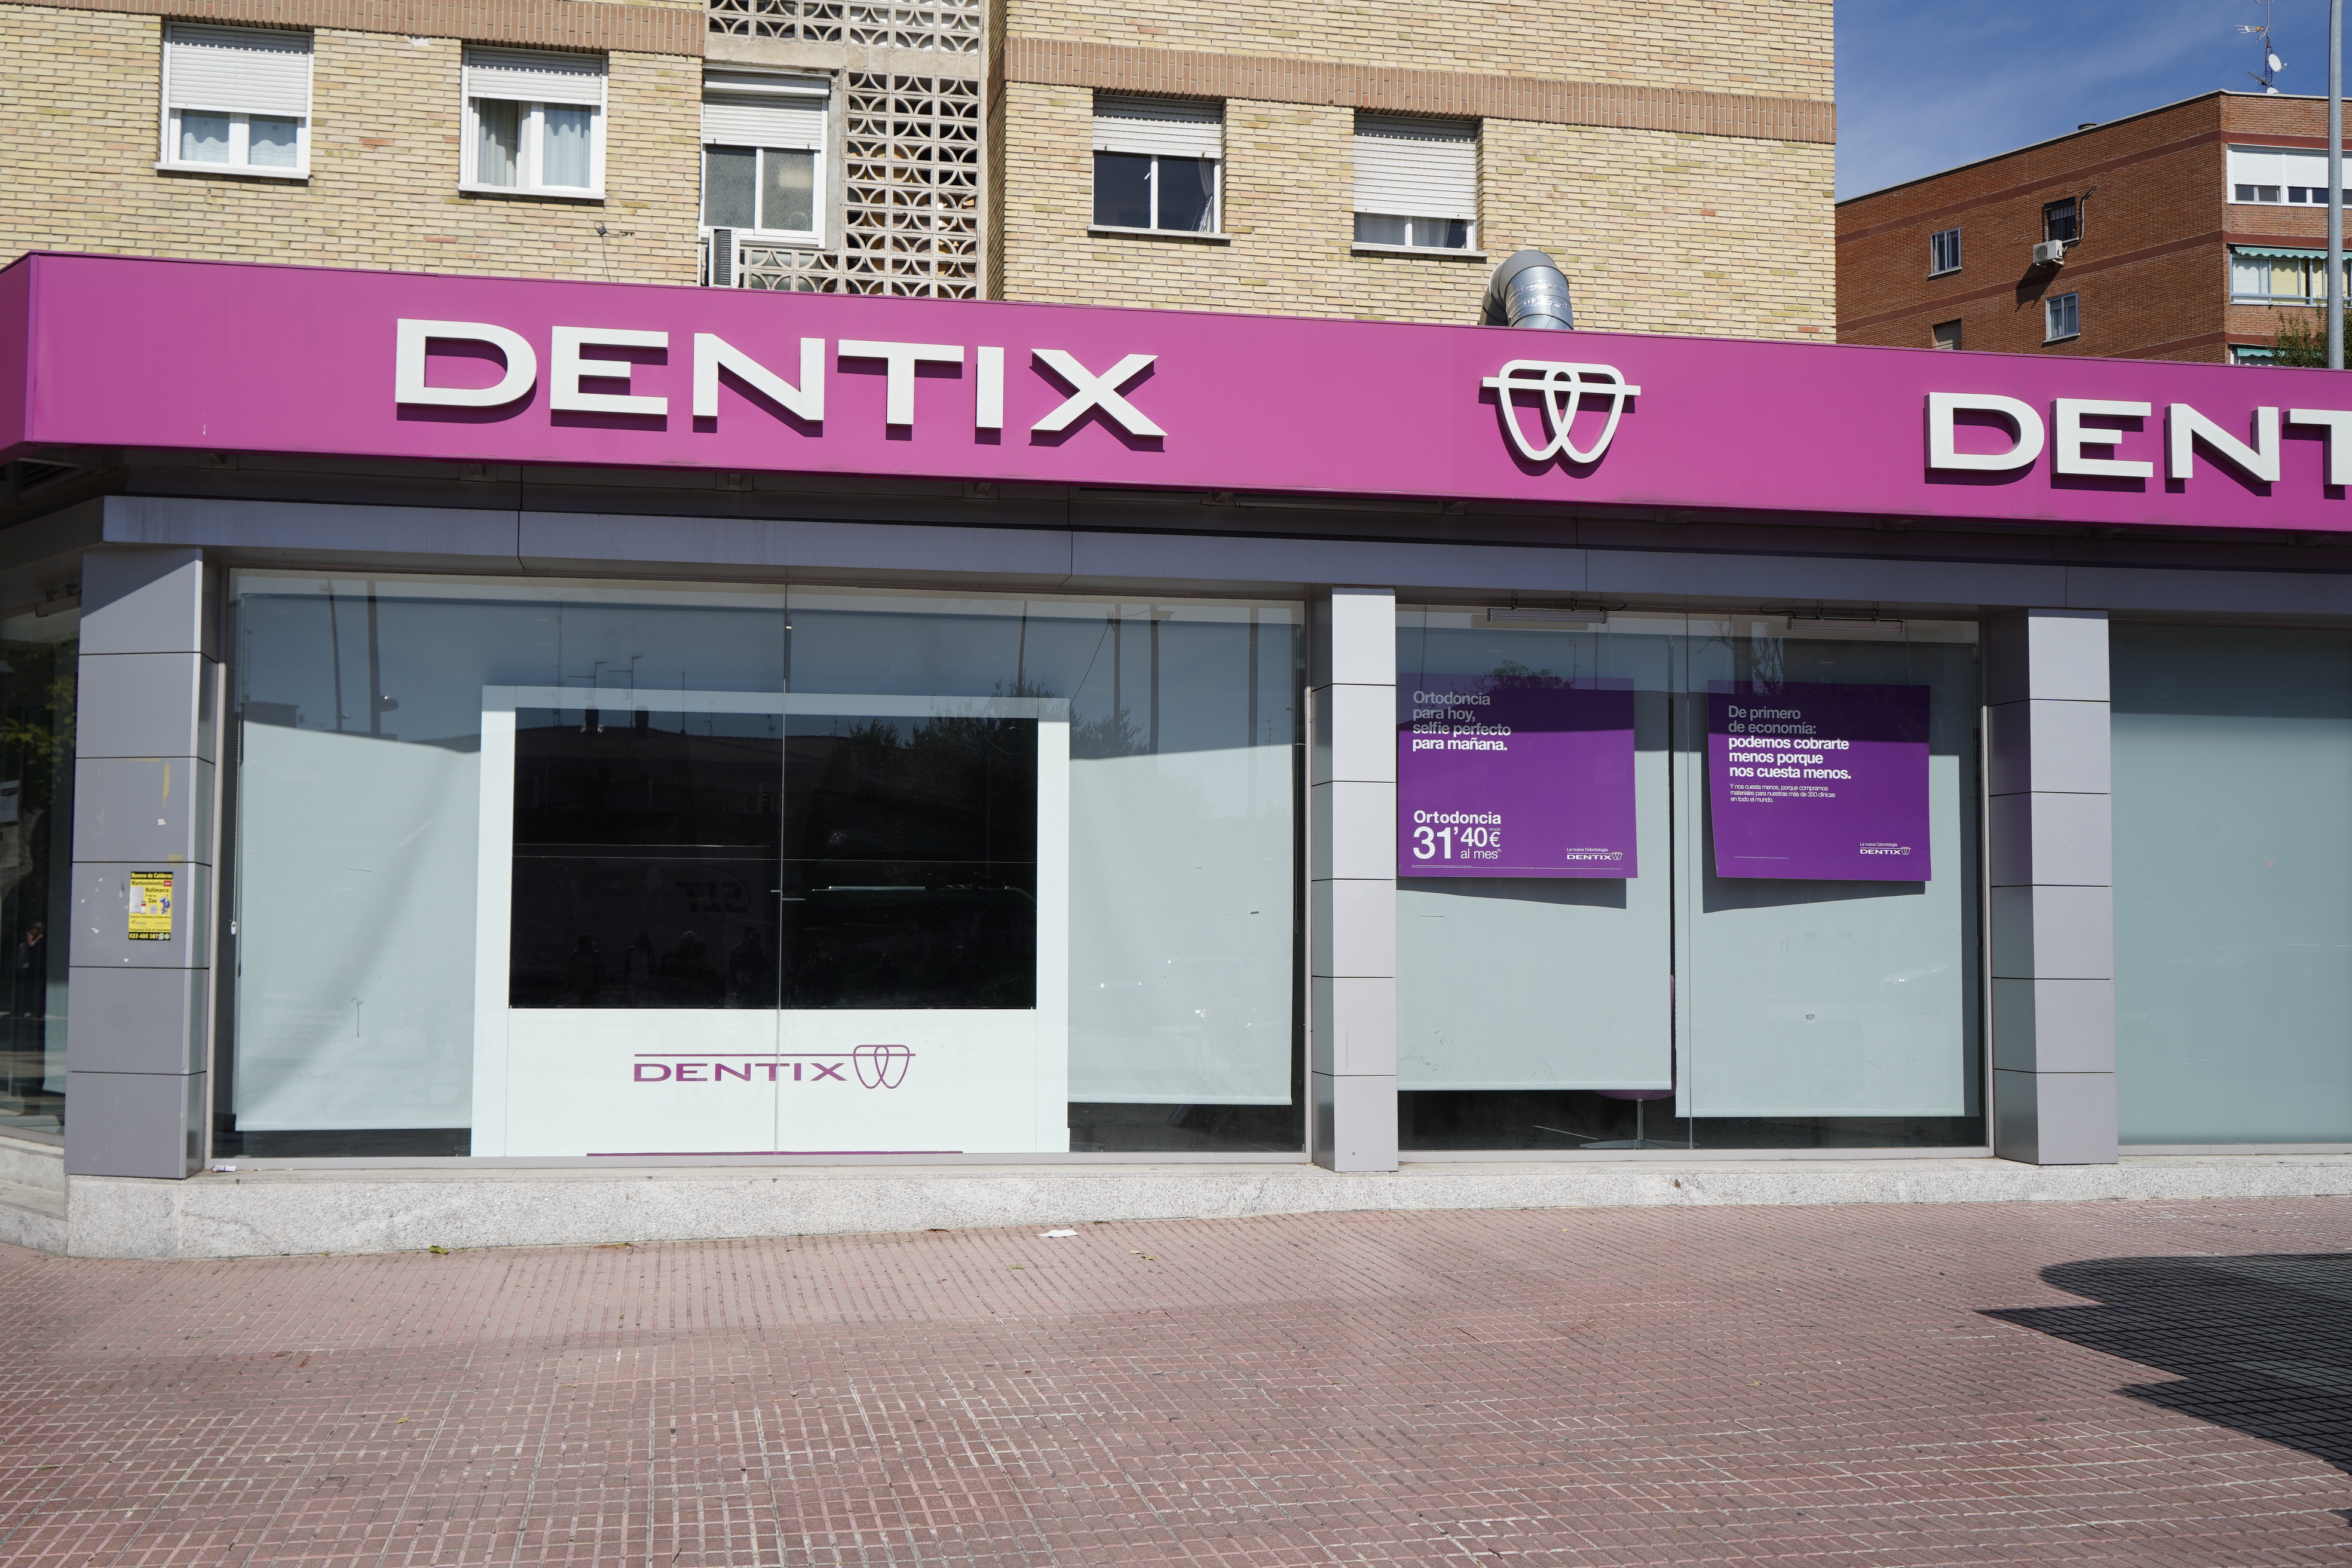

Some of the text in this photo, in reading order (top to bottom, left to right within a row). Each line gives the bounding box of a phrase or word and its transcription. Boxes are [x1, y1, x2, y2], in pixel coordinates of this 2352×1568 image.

[395, 318, 1167, 436] DENTIX
[1925, 392, 2352, 486] DENT
[1413, 691, 1490, 705] Ortodoncia
[1413, 707, 1475, 722] para hoy,
[1728, 705, 1801, 721] De primero
[1413, 722, 1511, 737] selfie perfecto
[1728, 720, 1817, 734] de economía:
[1413, 737, 1507, 752] para mañana.
[1729, 736, 1849, 750] podemos cobrarte
[1729, 752, 1823, 766] menos porque
[1730, 766, 1852, 779] nos cuesta menos.
[1414, 810, 1501, 824] Ortodoncia
[1460, 849, 1469, 859] al
[633, 1063, 847, 1082] DENTIX
